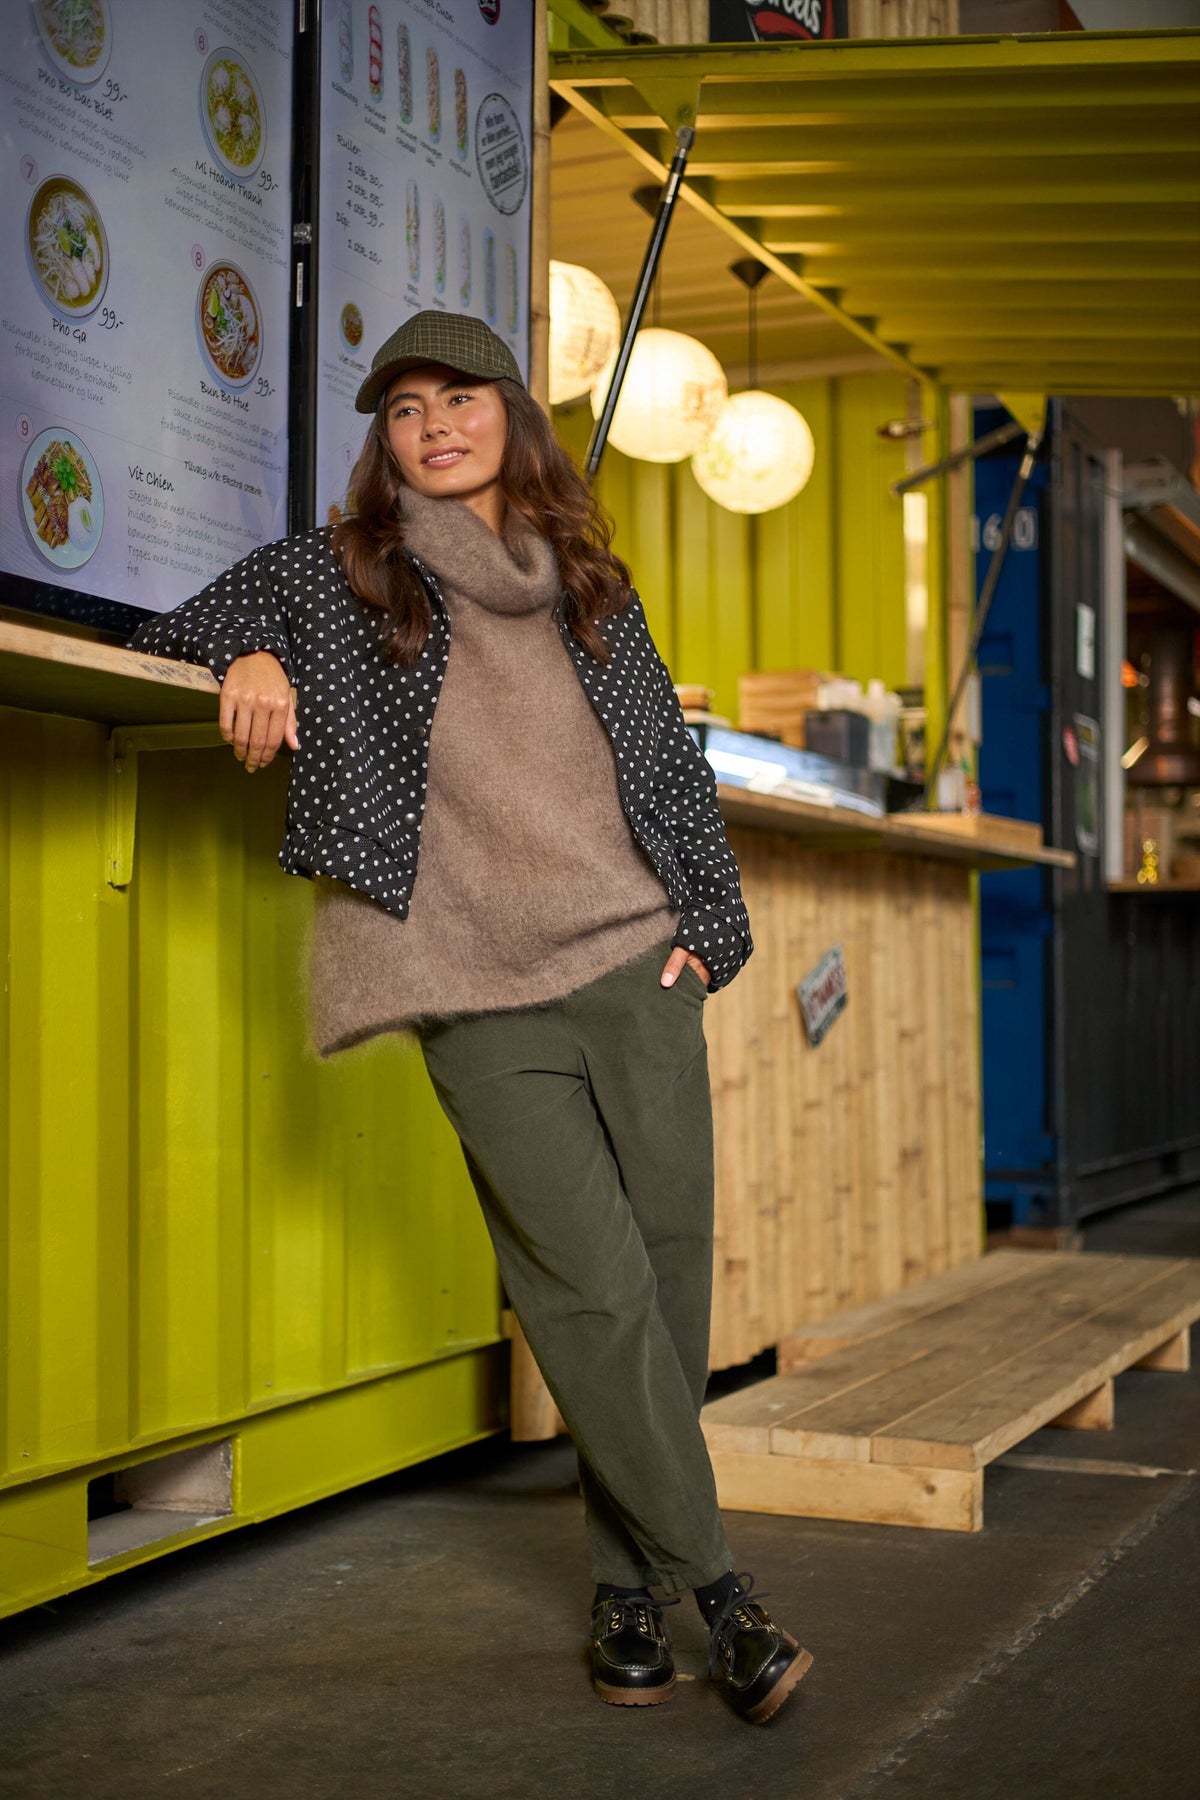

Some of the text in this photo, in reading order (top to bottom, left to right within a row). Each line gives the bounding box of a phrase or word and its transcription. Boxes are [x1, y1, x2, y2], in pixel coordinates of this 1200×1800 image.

[198, 35, 205, 51] 6
[38, 67, 56, 88] Pho
[102, 79, 127, 101] 99,-
[26, 161, 34, 179] 7
[257, 170, 279, 191] 99,-
[195, 251, 202, 267] 8
[97, 307, 124, 330] 99,-
[52, 317, 87, 345] Pho Ga
[254, 377, 276, 397] 99,-
[21, 420, 29, 436] 9
[128, 465, 175, 492] Vit Chien
